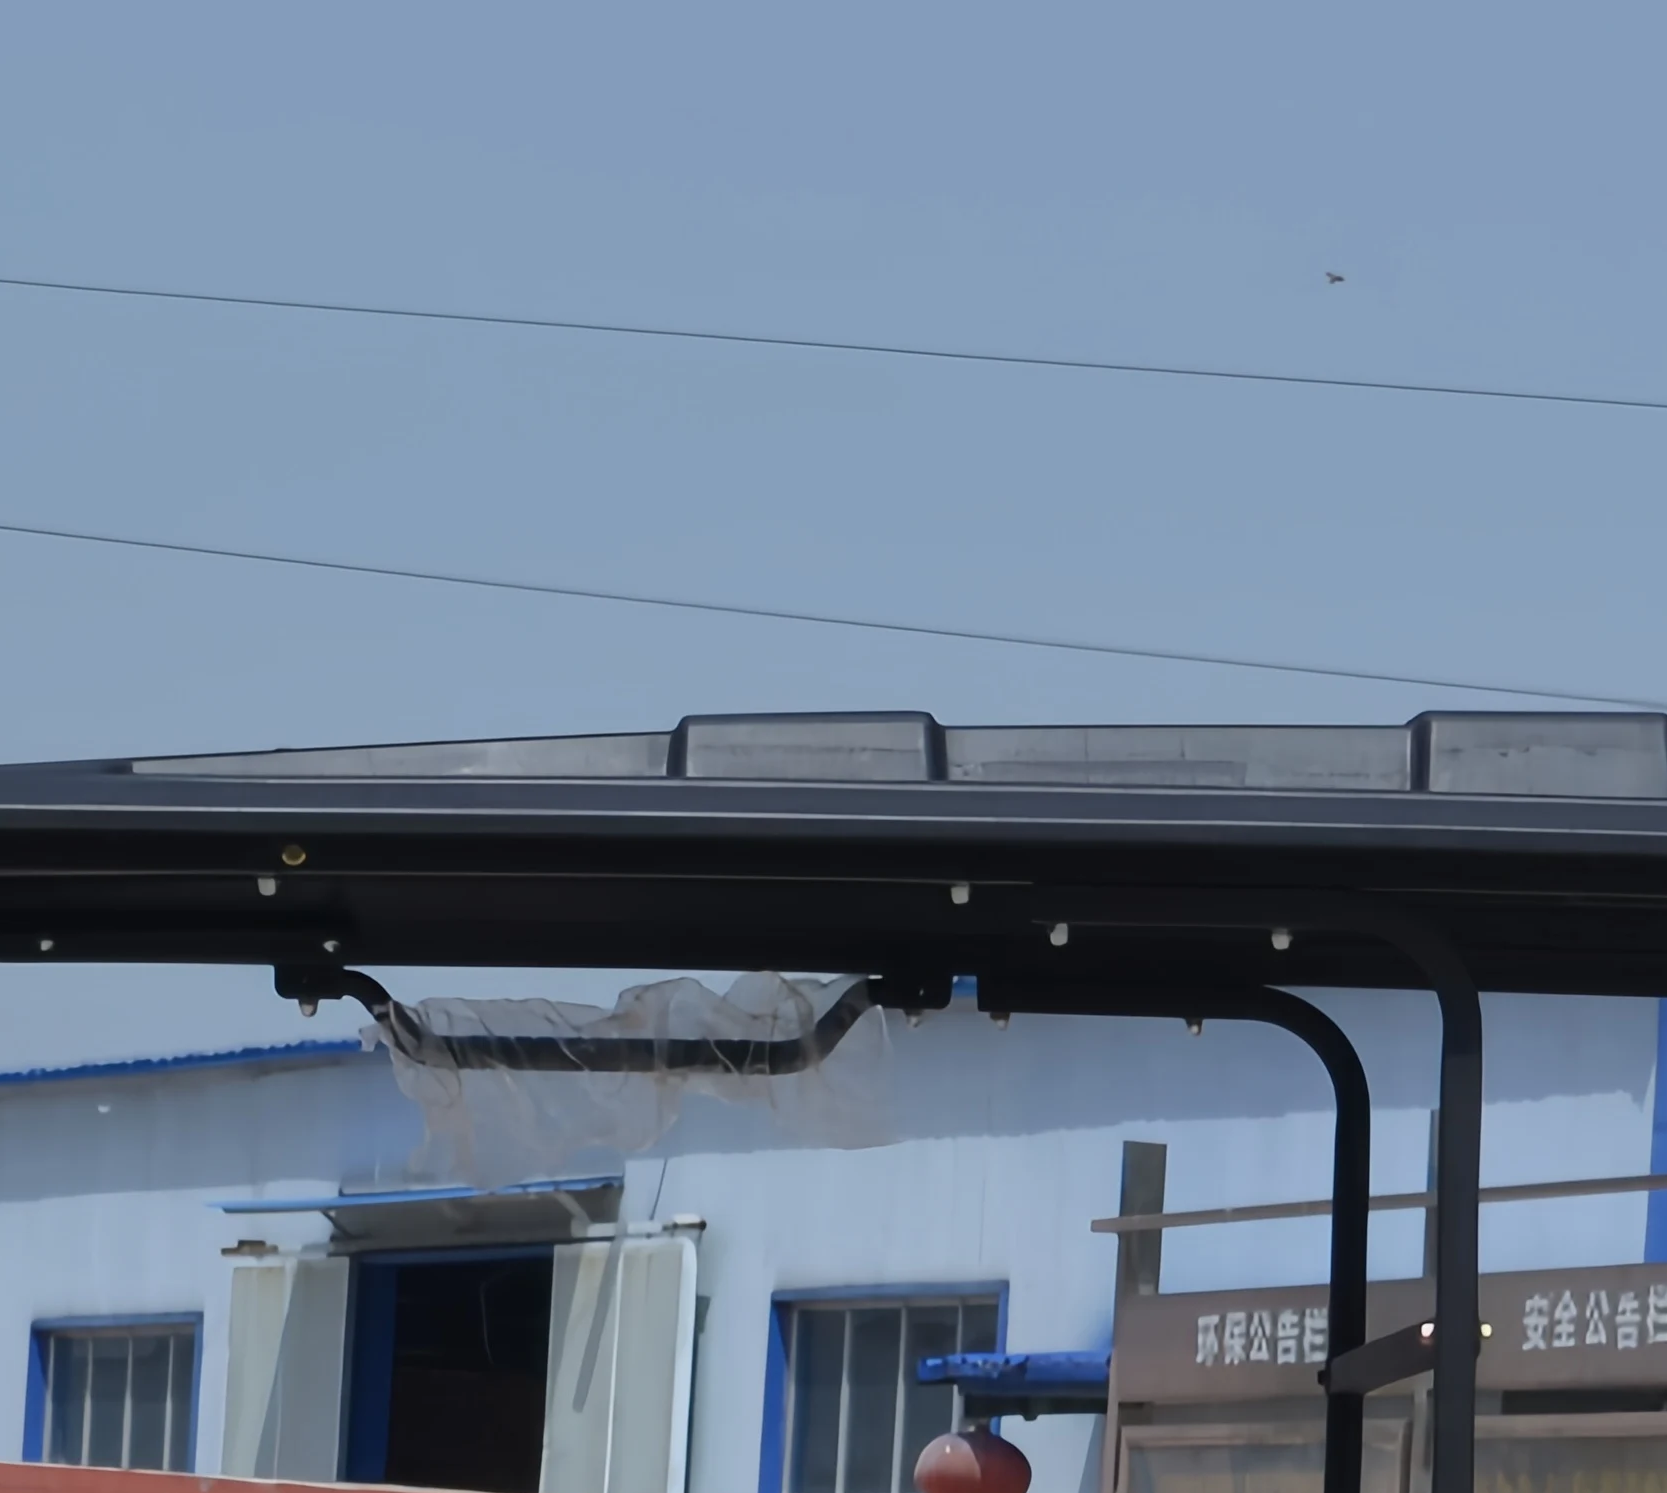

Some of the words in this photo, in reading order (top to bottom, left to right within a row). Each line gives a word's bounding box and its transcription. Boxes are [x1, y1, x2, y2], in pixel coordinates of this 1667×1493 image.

[1195, 1306, 1329, 1367] 环保公告栏
